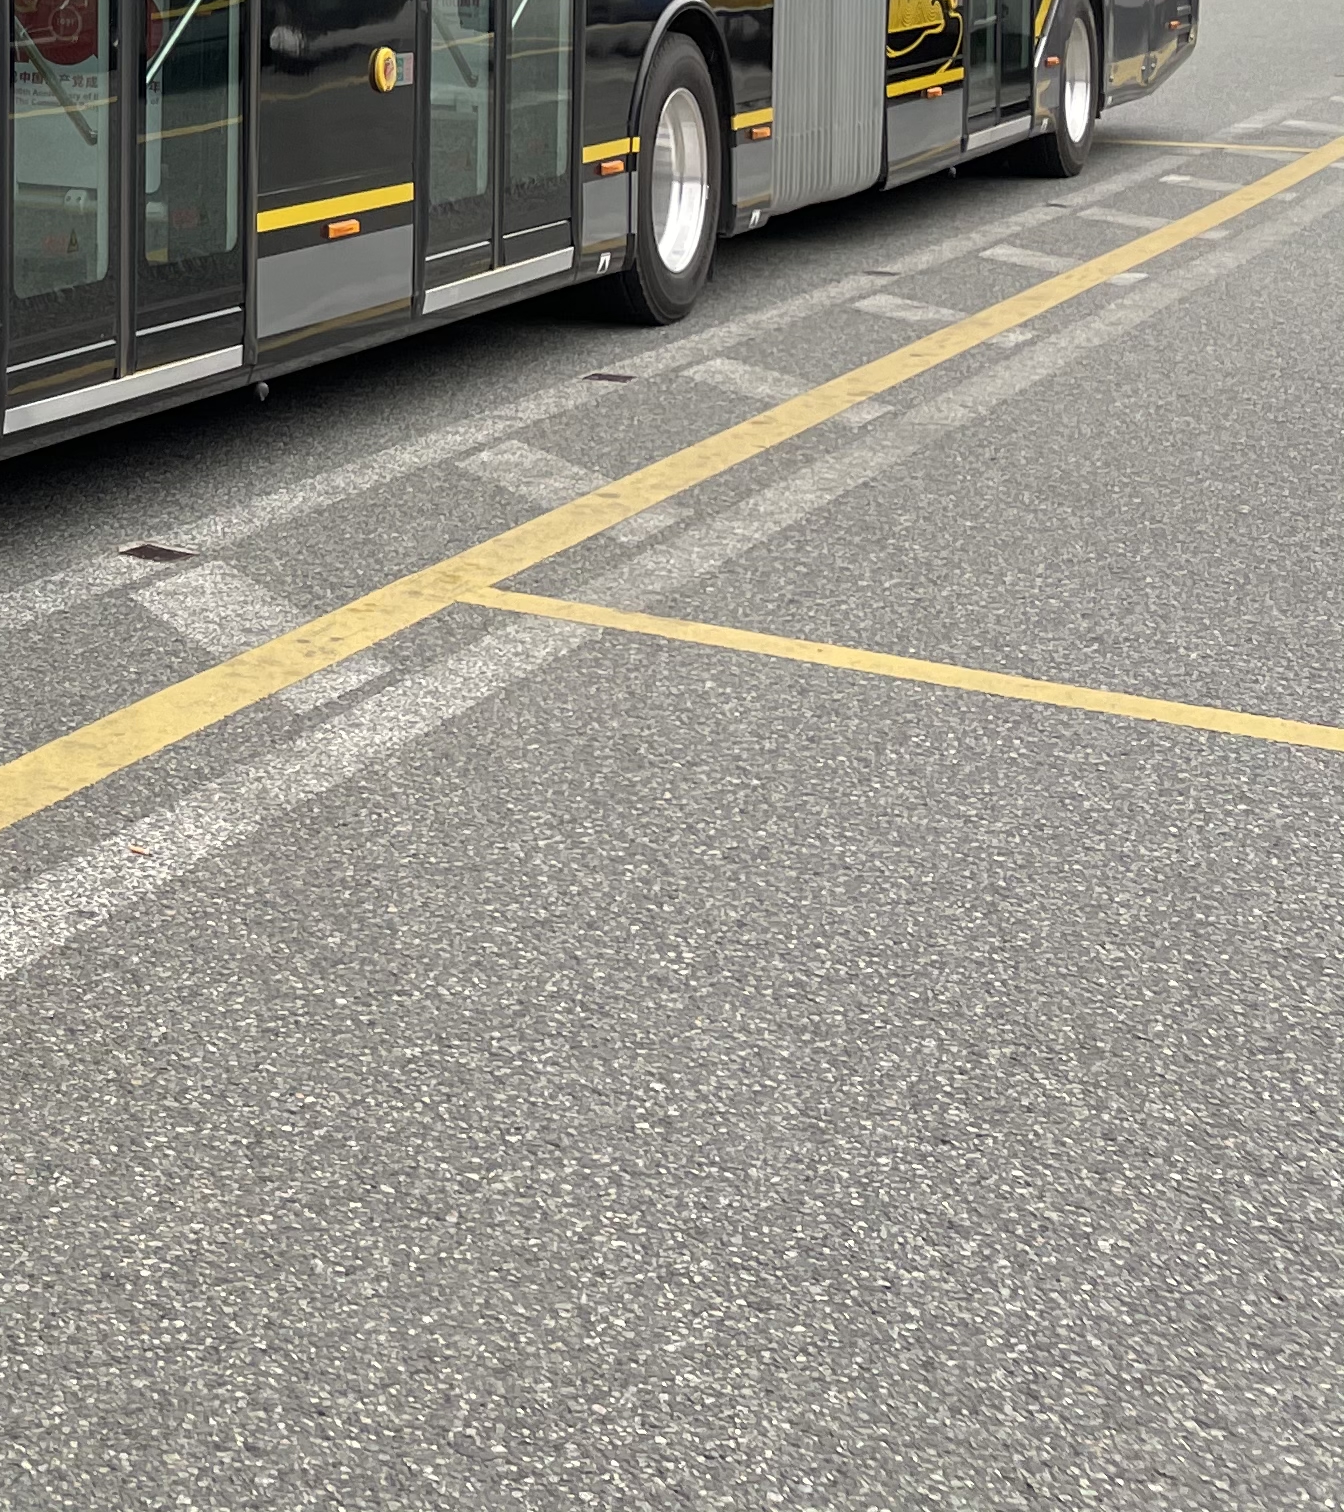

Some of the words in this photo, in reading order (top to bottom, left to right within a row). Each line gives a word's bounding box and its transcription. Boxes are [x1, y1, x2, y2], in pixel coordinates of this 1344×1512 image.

[14, 70, 99, 89] 中国产党成
